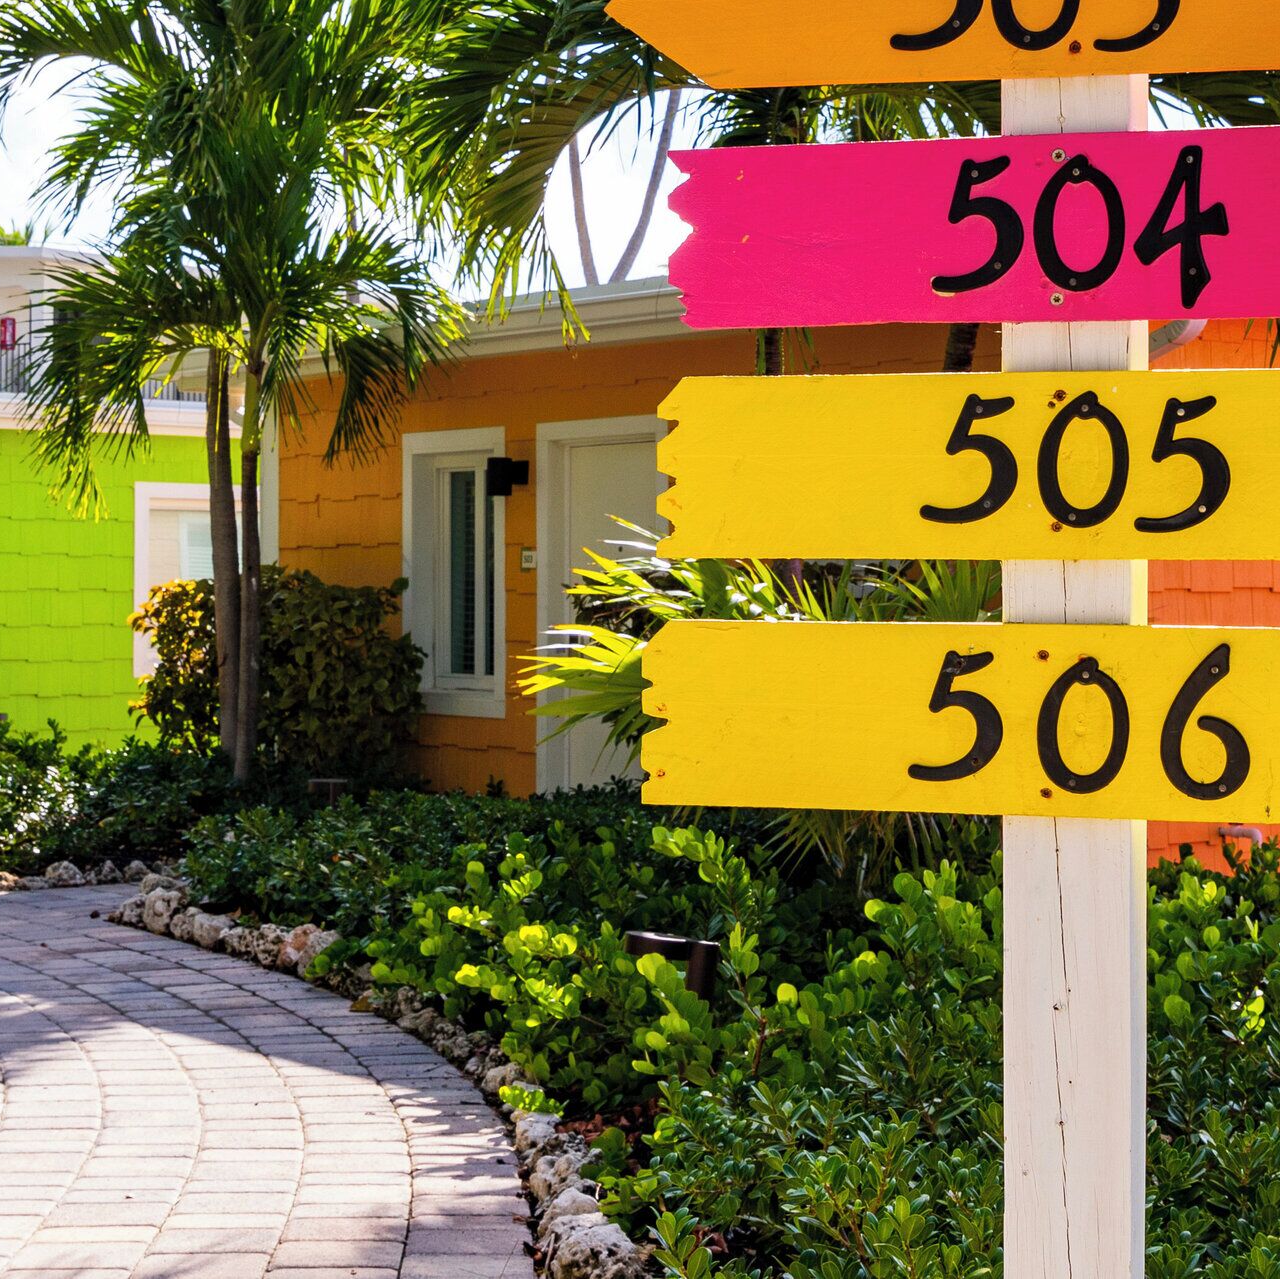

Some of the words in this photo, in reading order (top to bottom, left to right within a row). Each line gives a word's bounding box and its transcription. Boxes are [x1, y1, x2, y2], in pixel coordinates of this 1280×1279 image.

[931, 145, 1230, 310] 504
[919, 390, 1231, 533] 505
[907, 643, 1251, 801] 506
